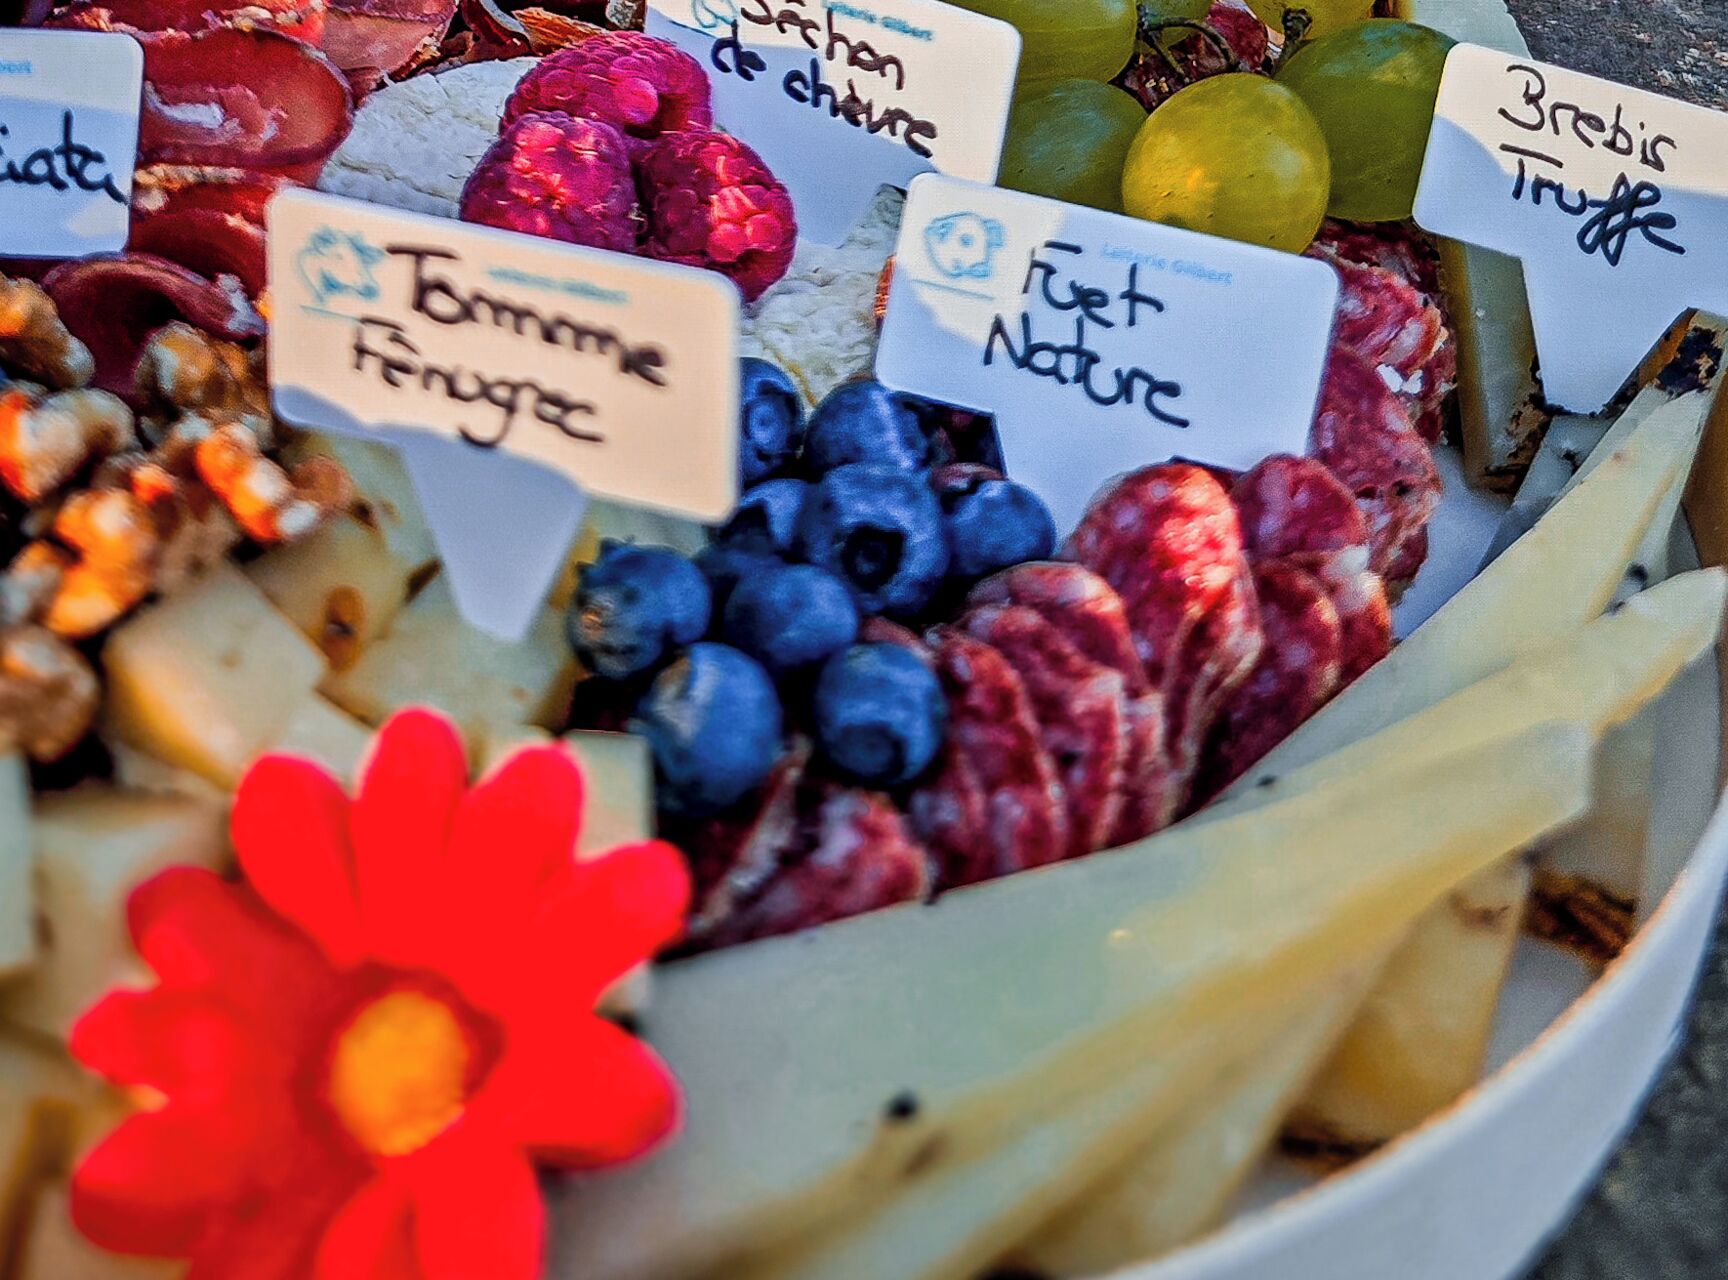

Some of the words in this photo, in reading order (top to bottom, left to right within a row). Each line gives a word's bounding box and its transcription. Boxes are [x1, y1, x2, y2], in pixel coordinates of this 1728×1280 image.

[710, 18, 767, 81] de
[1022, 240, 1165, 329] Fuet
[983, 312, 1190, 429] Nature
